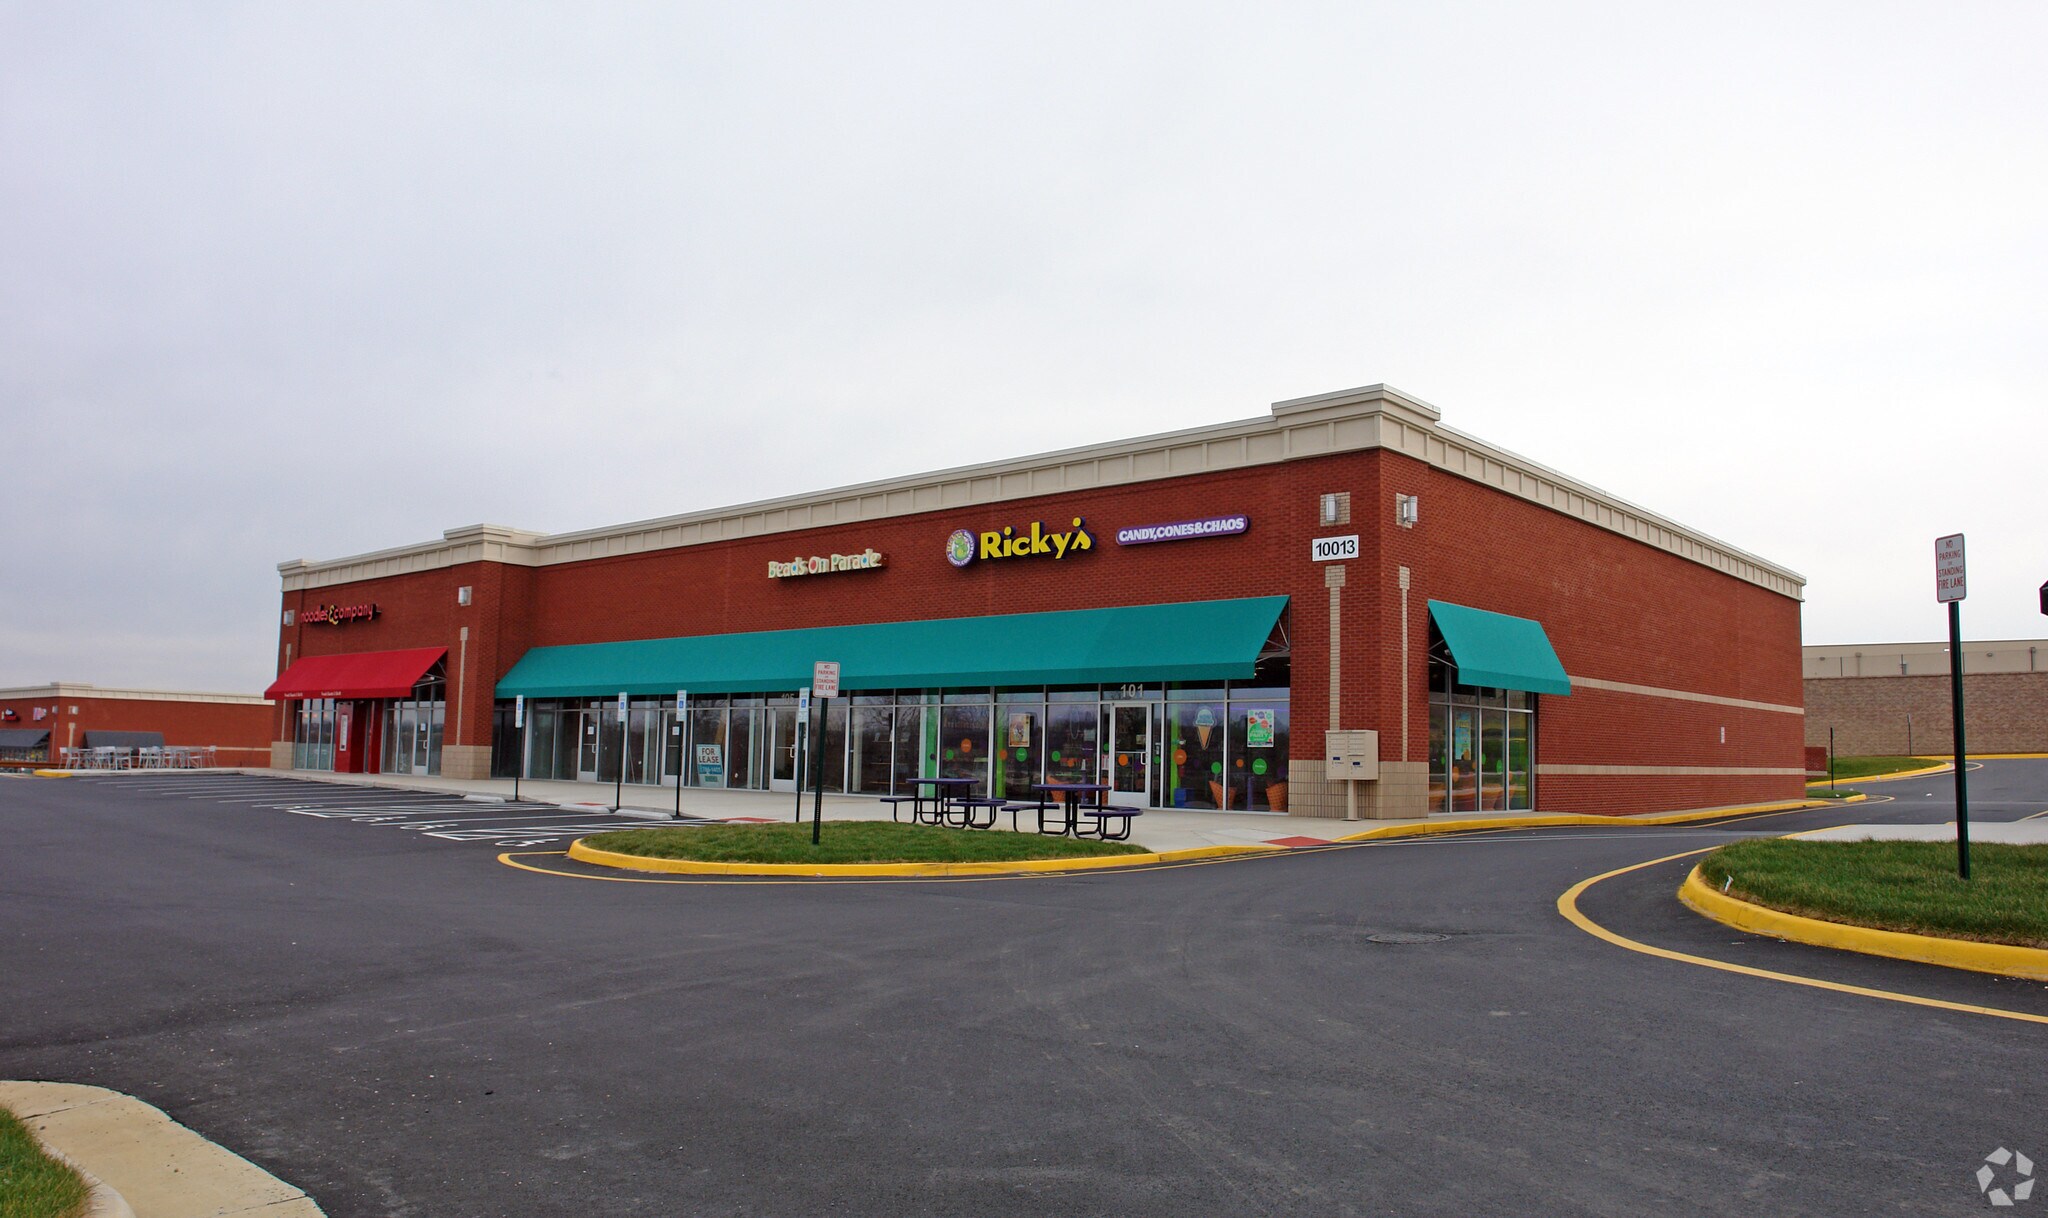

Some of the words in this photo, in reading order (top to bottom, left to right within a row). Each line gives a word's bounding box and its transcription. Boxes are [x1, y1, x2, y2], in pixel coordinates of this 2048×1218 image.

[980, 517, 1091, 559] Ricky's
[1946, 540, 1953, 549] NO
[1315, 539, 1356, 557] 10013
[1938, 549, 1961, 561] PARKING
[768, 556, 808, 579] Beads
[808, 555, 830, 574] On
[830, 548, 882, 572] Parade
[1938, 566, 1964, 578] STANDING
[1938, 579, 1950, 590] FIRE
[1950, 576, 1964, 589] LANE
[1120, 683, 1144, 698] 101
[701, 747, 716, 756] FOR
[698, 756, 720, 764] LEASE
